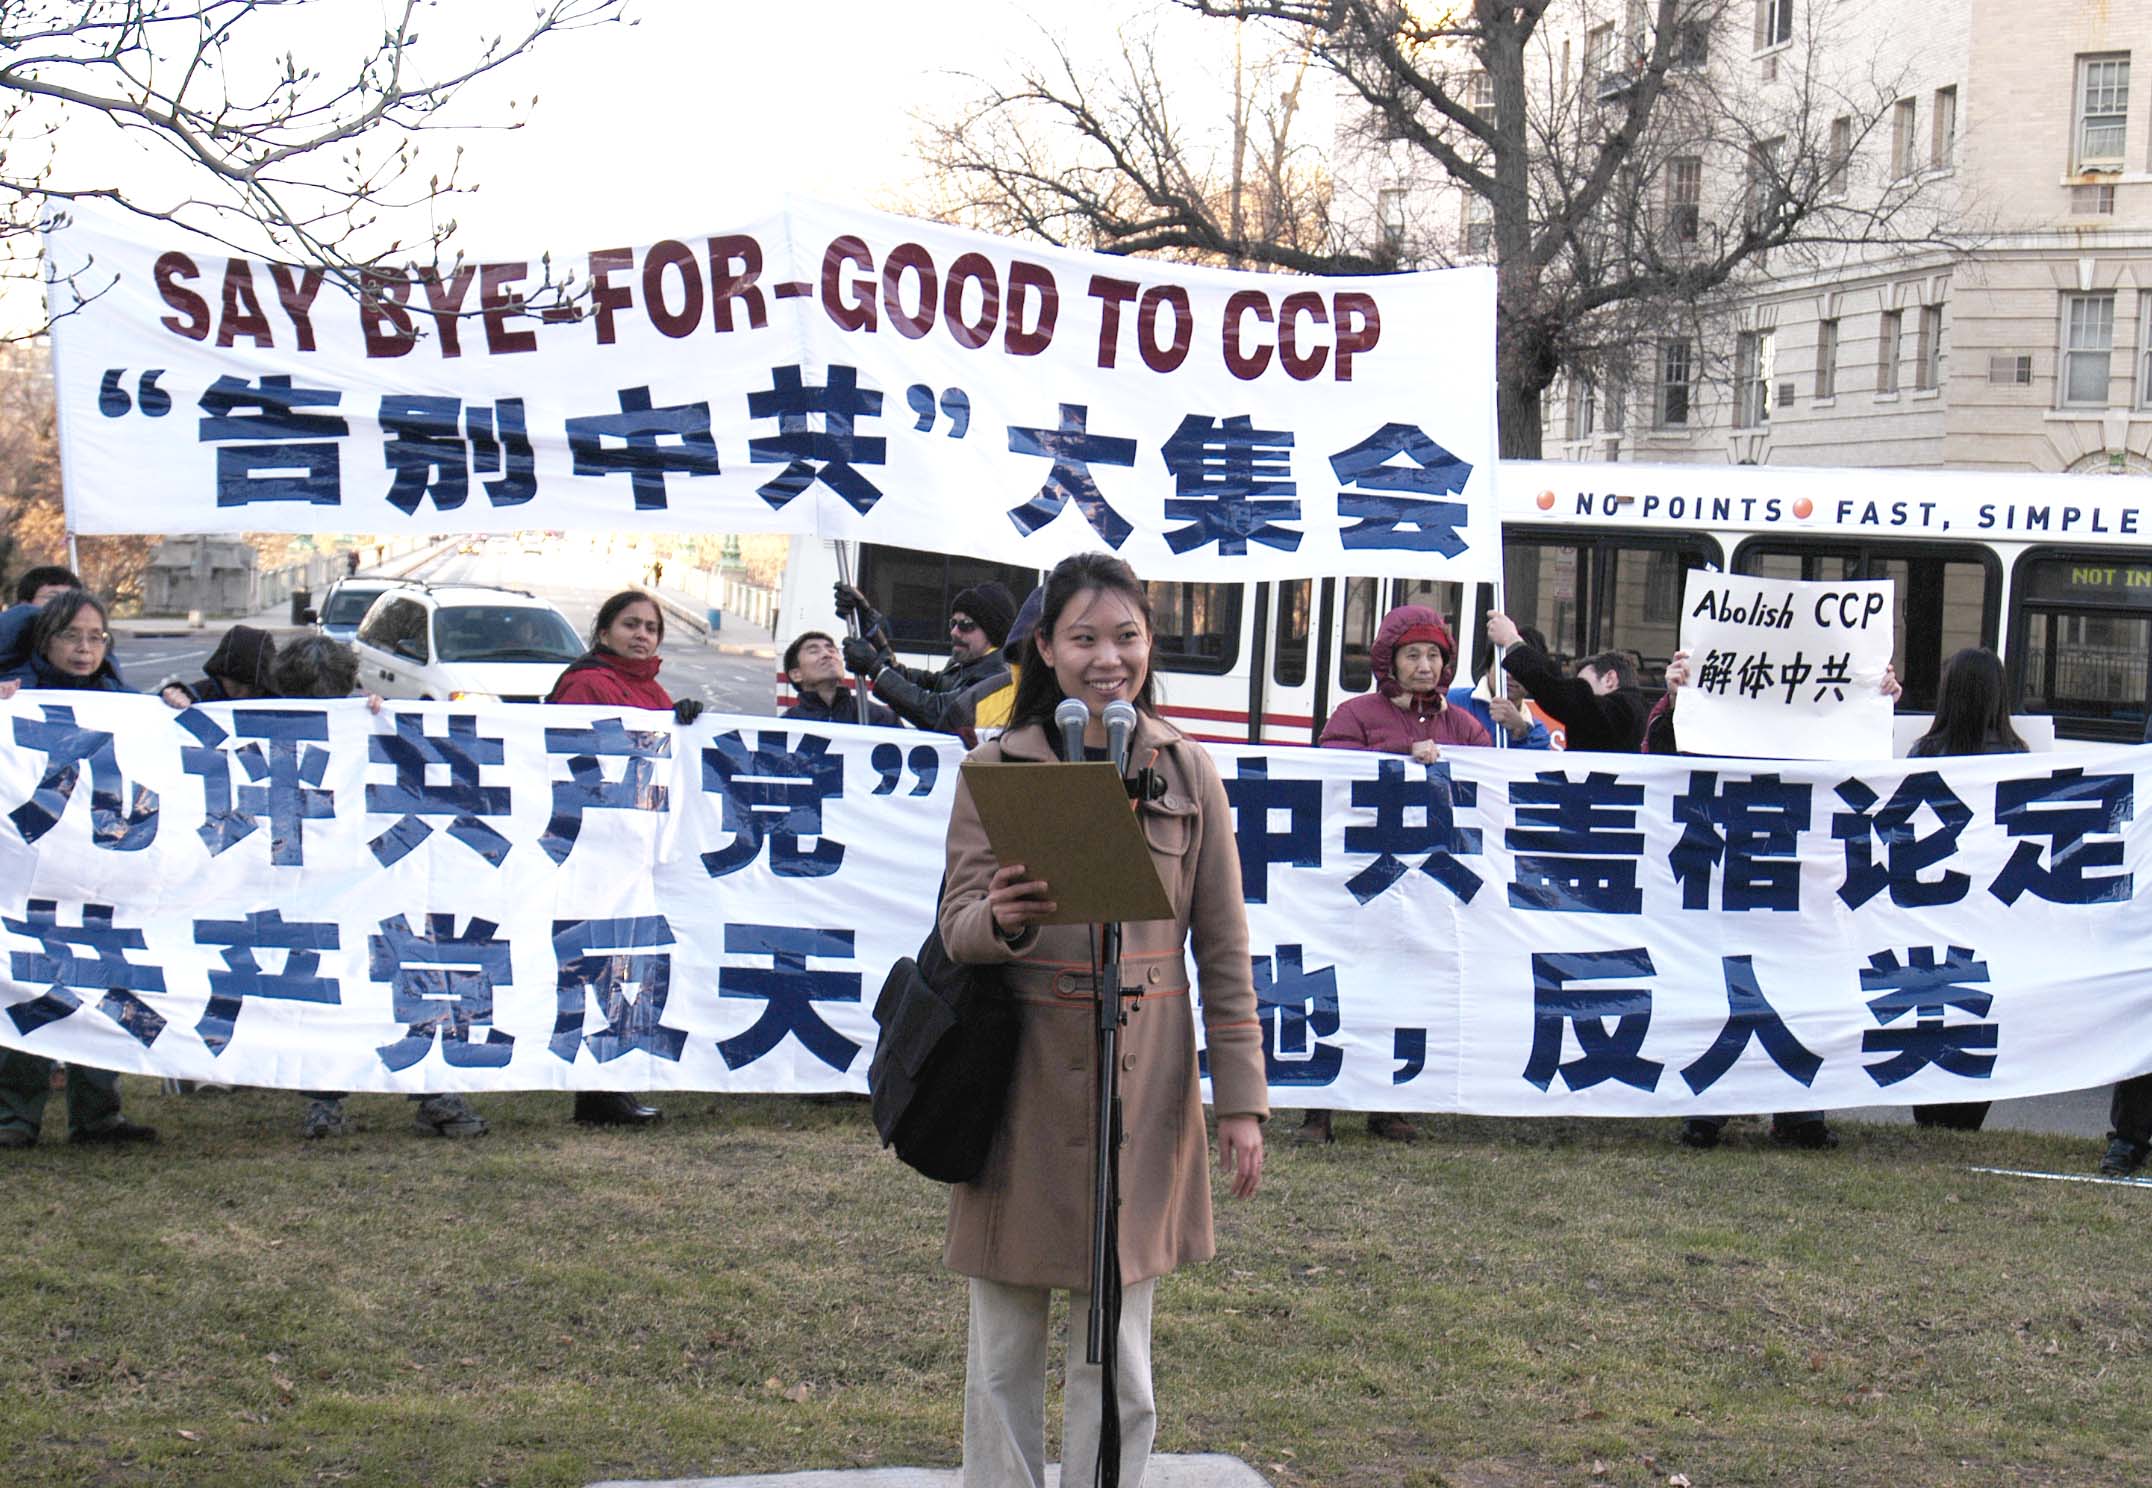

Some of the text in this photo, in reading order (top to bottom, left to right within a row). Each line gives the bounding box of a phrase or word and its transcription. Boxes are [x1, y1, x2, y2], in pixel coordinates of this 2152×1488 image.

[153, 250, 326, 352] SAY
[1088, 274, 1193, 373] TO
[1222, 289, 1381, 382] CCP
[1576, 492, 1781, 522] NO POINTS
[1836, 499, 2140, 534] FAST, SIMPLE
[2071, 567, 2152, 588] NOT IN
[1692, 589, 1884, 629] Abolish CCP
[1697, 649, 1852, 704] 解体中共
